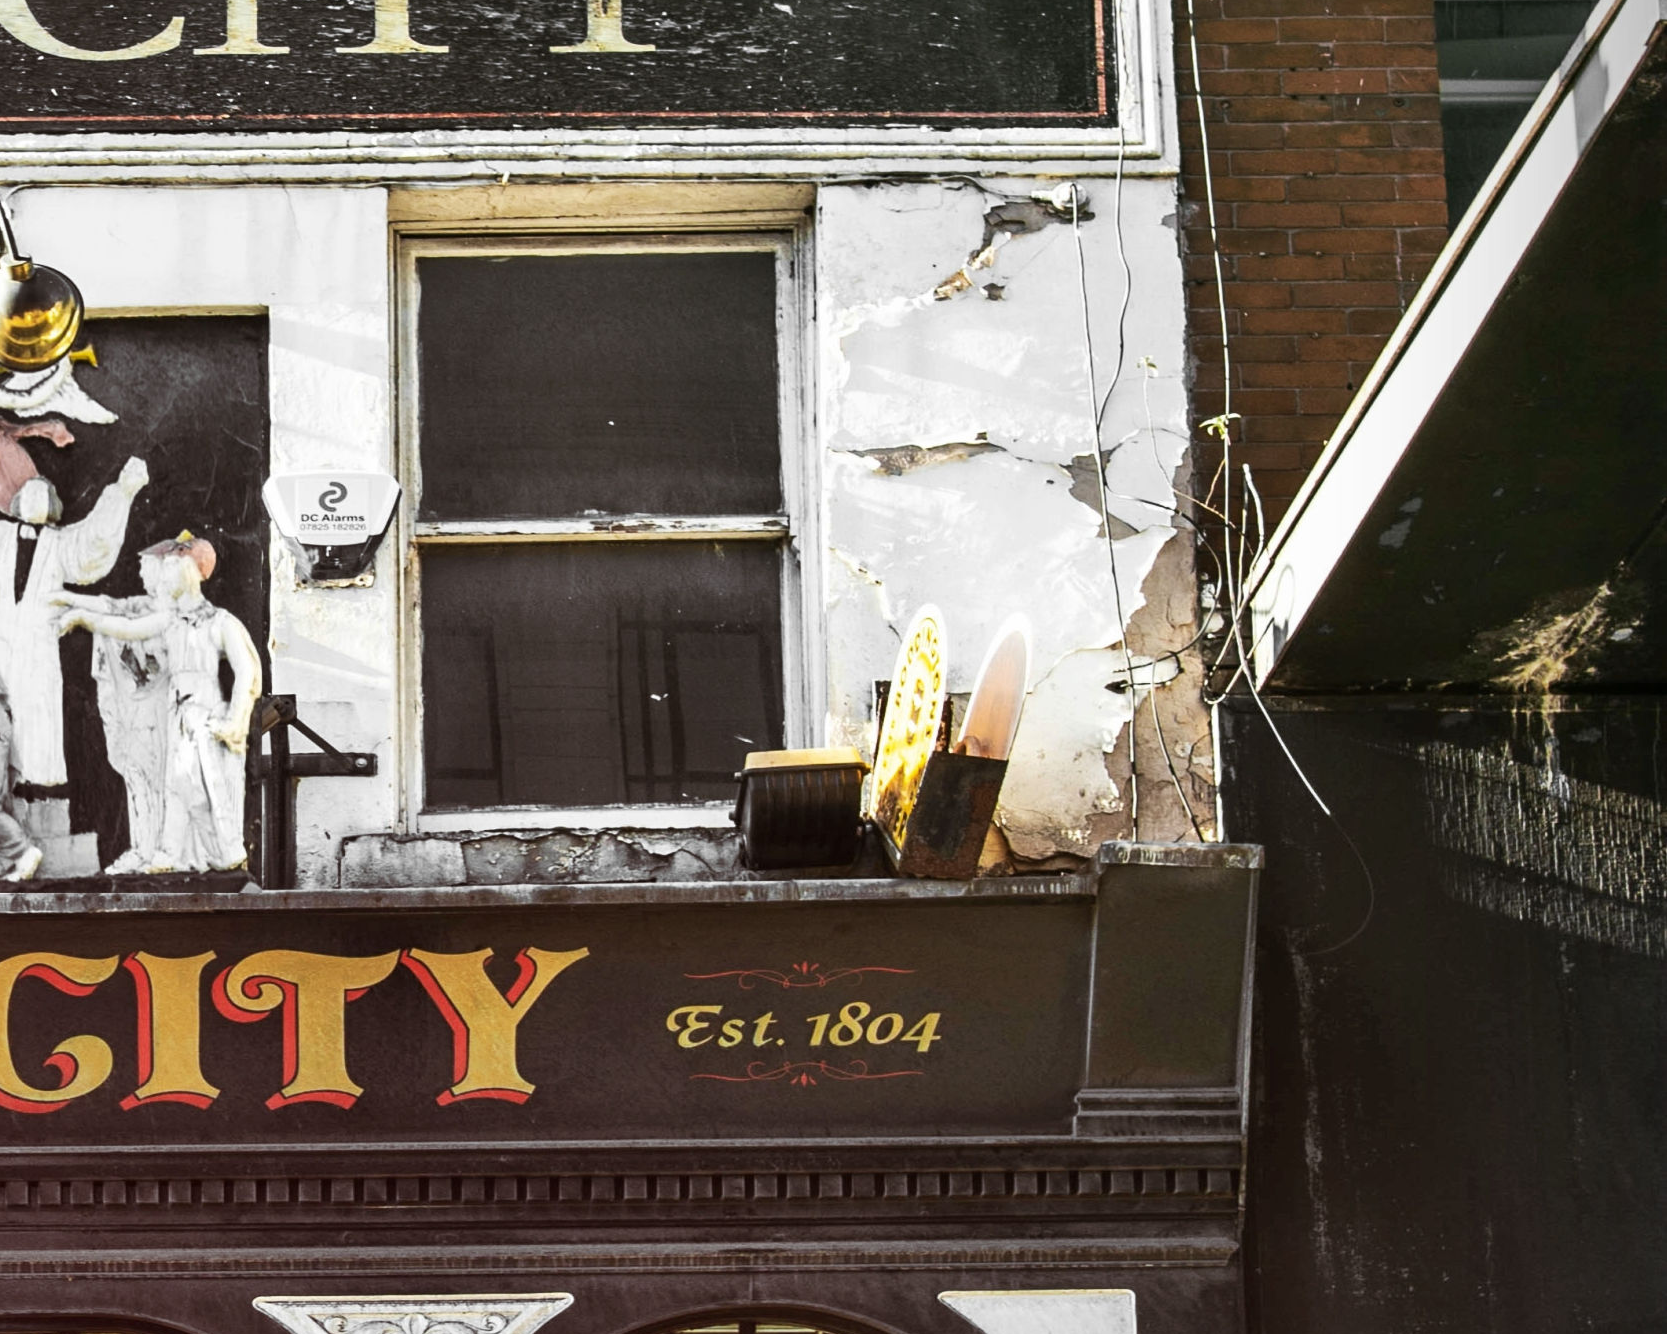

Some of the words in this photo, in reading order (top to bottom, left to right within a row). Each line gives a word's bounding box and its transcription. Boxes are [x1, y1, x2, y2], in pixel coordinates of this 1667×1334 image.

[300, 513, 319, 522] DC
[322, 513, 366, 522] Alarms
[666, 1005, 785, 1049] Est.
[806, 1001, 942, 1052] 1804
